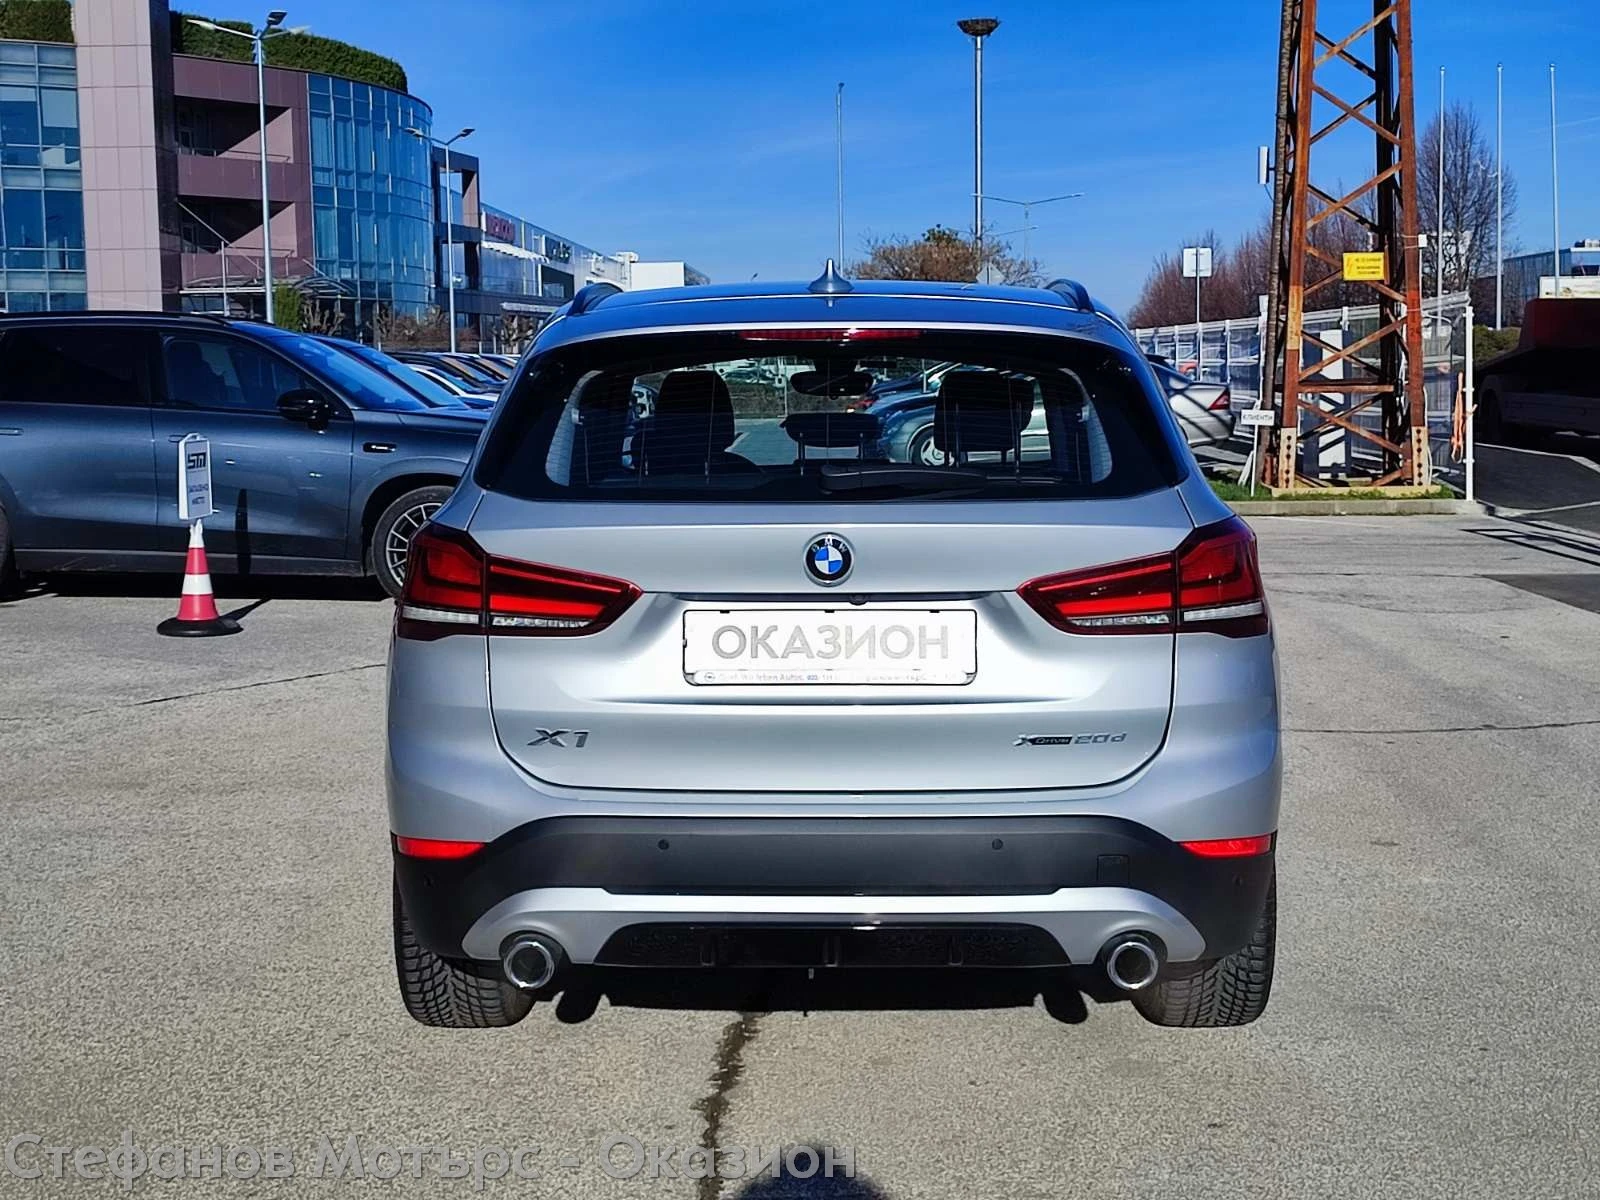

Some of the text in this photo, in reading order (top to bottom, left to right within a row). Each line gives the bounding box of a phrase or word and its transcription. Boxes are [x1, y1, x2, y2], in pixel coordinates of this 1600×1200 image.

[711, 624, 949, 660] ОКАЗИОН
[527, 728, 590, 748] X1
[1075, 731, 1128, 746] 20d
